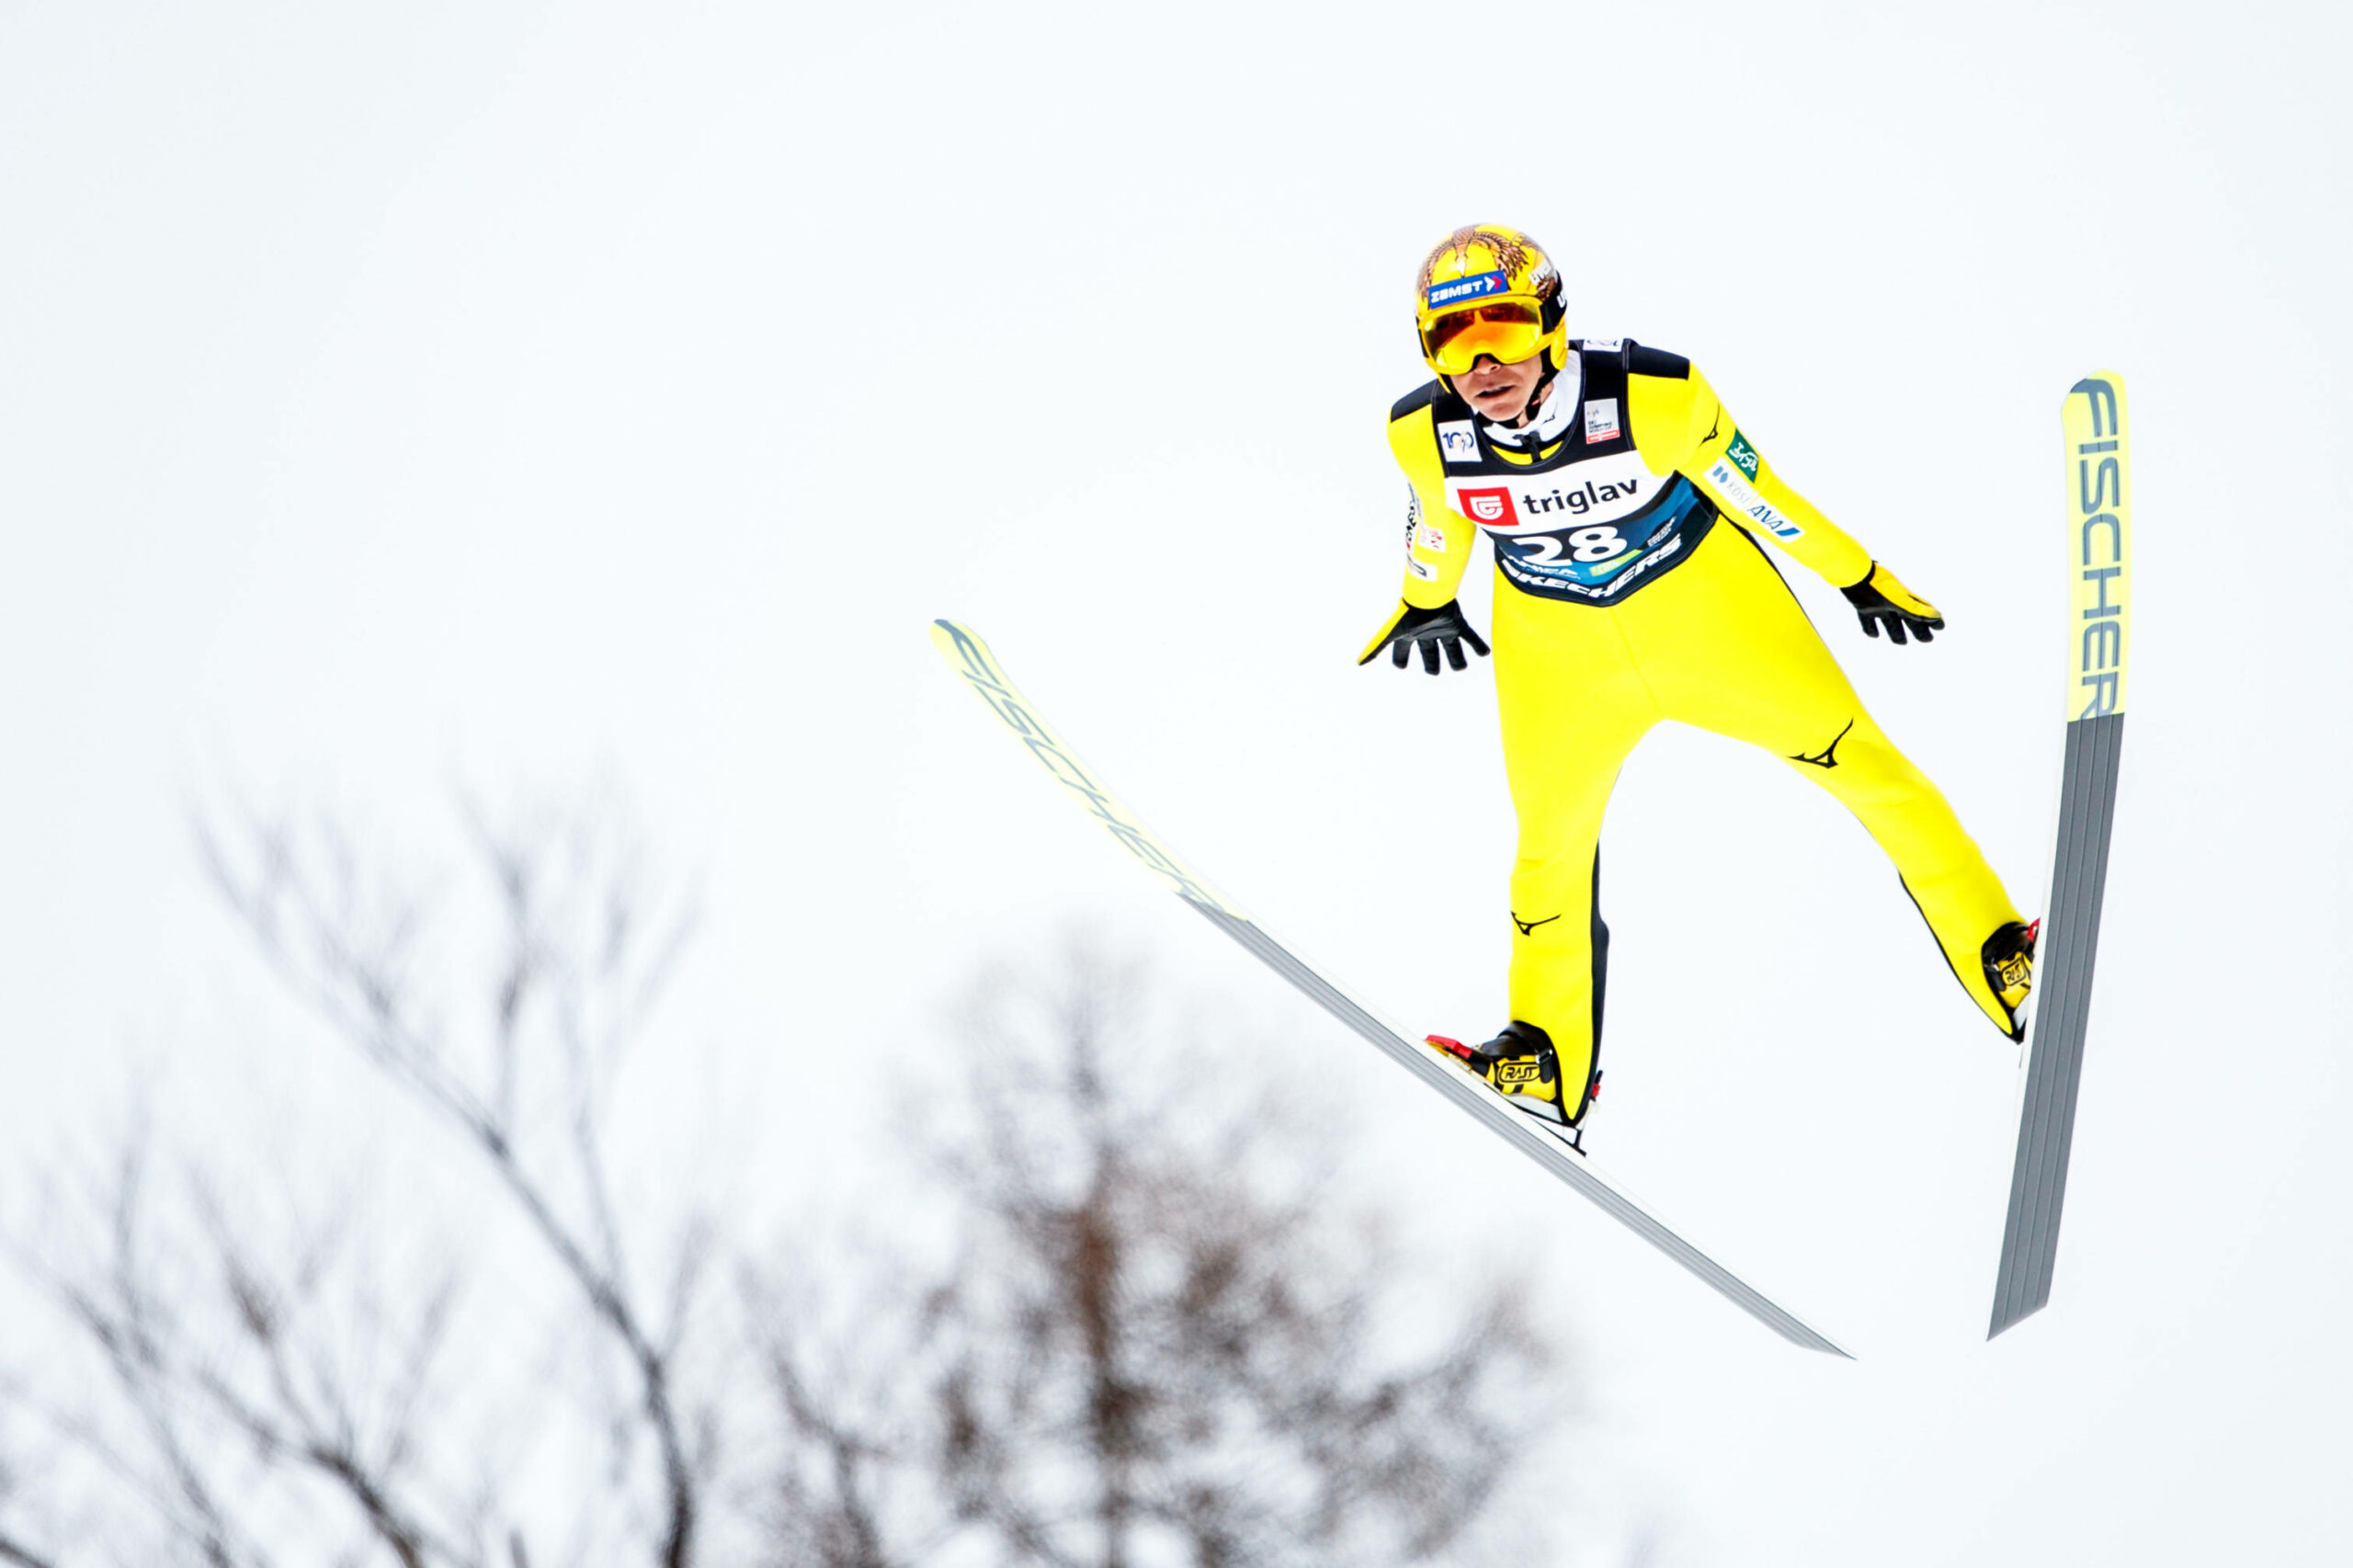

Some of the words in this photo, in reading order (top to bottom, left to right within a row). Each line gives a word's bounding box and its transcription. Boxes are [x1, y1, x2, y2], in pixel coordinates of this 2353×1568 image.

[1522, 479, 1637, 515] triglav
[1746, 505, 1783, 530] ANA
[1512, 526, 1627, 567] 28
[2069, 378, 2121, 720] FISCHER
[934, 619, 1225, 913] FISCHER
